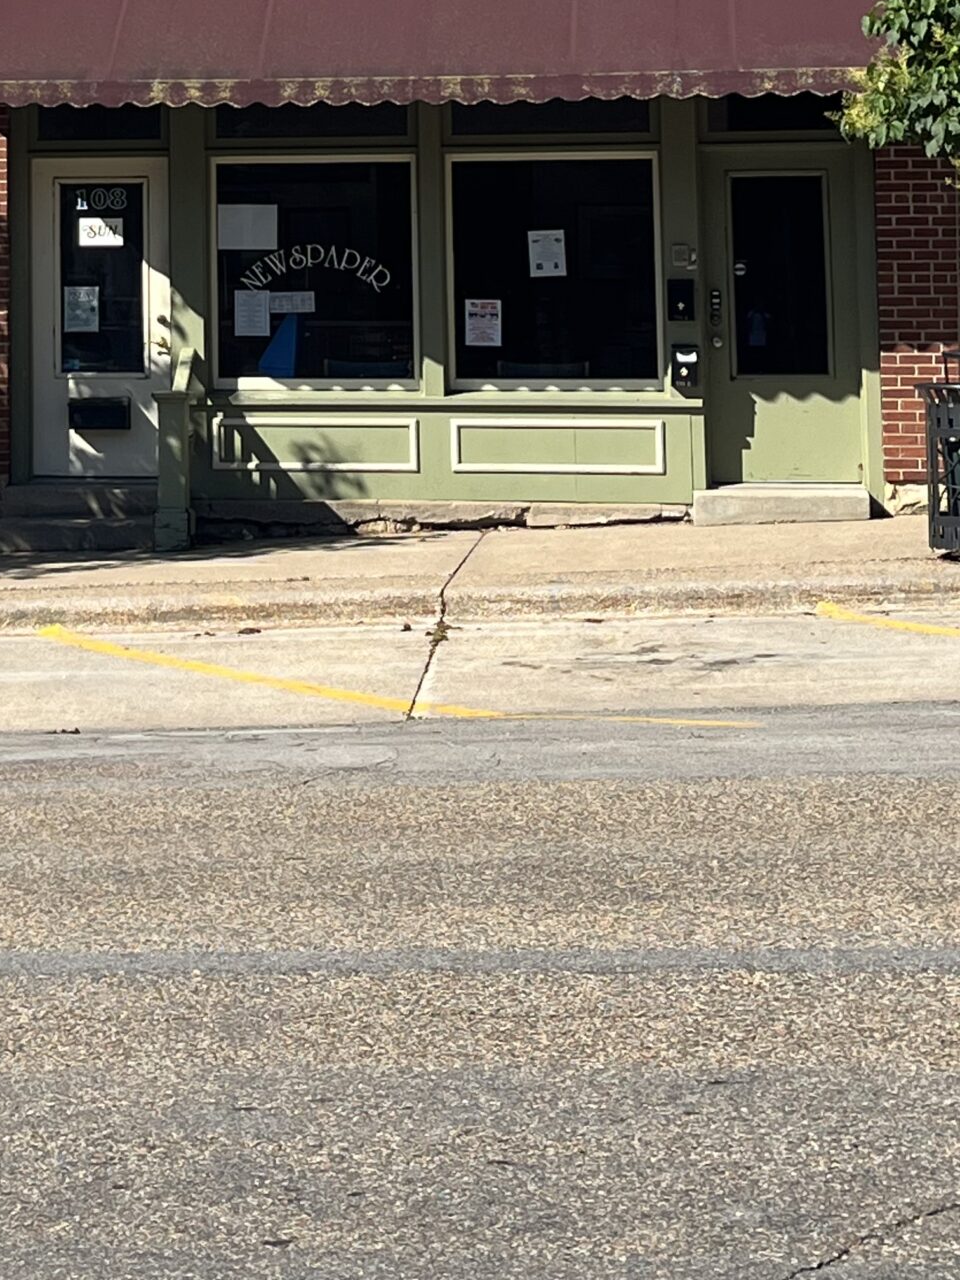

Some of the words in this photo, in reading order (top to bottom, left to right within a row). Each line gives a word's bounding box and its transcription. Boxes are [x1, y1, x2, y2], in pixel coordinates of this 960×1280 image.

[76, 188, 128, 211] 108
[83, 223, 119, 240] SUN
[240, 243, 391, 294] NEWSPAPER
